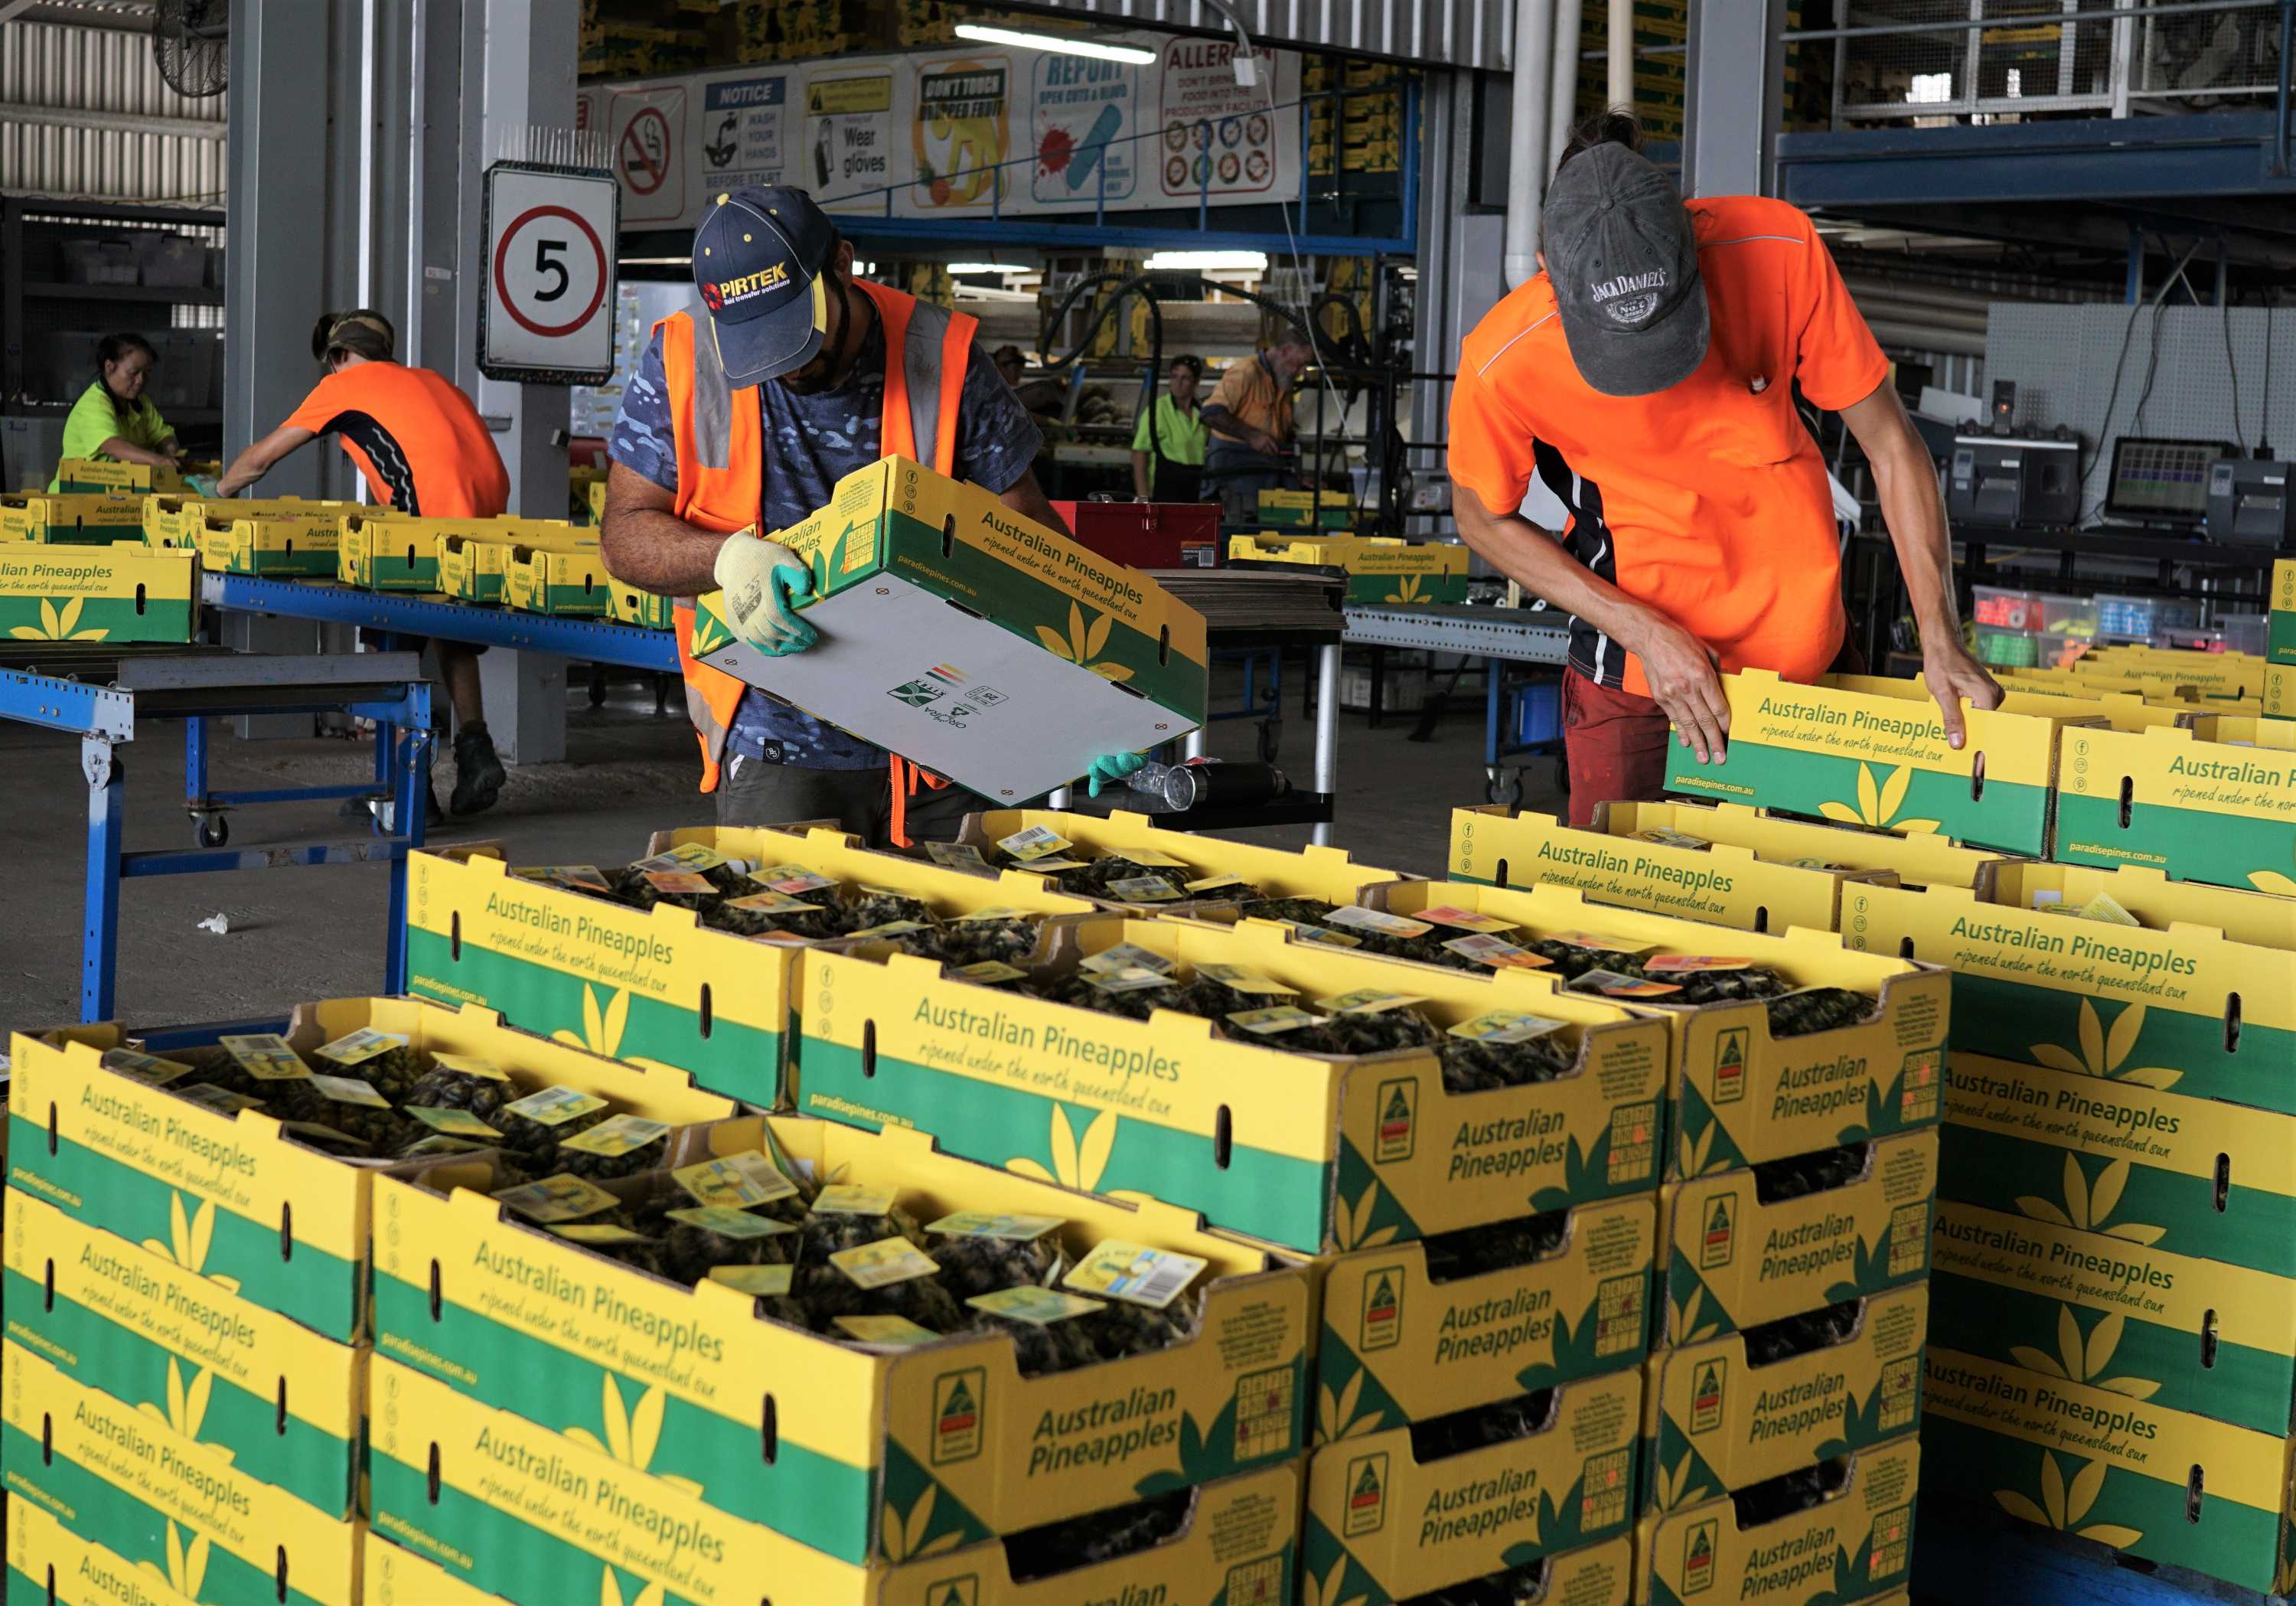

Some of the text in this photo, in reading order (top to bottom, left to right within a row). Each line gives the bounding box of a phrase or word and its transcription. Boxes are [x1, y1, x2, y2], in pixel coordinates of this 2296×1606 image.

[719, 84, 773, 106] NOTICE
[844, 126, 876, 147] Wear
[844, 153, 885, 179] gloves
[534, 239, 569, 302] 5
[719, 260, 789, 299] PIRTEK
[1591, 267, 1666, 302] JACK DANIEL'S
[96, 504, 141, 515] Australian
[33, 564, 113, 580] Pineapples
[897, 554, 977, 597] paradisepines.com.au
[980, 511, 1144, 606] Australian Pineapples
[983, 536, 1140, 622] ripened under the north queensland sun
[1358, 553, 1436, 564] Australian Pineapples
[983, 692, 999, 701] 25
[1759, 697, 1949, 742] Australian Pineapples
[1761, 726, 1943, 762] ripened under the north queensland sun
[1675, 775, 1755, 796] paradisepines.com.au
[2168, 756, 2281, 788] Australian
[2172, 784, 2274, 808] ripened under the
[1538, 841, 1733, 893] Australian Pineapples
[2069, 842, 2167, 864] paradisepines.com.au
[1541, 870, 1726, 915] ripened under the north queensland sun
[486, 892, 673, 965] Australian Pineapples
[1951, 917, 2197, 976] Australian Pineapples
[491, 931, 667, 994] ripened under the north queensland sun
[1955, 948, 2186, 1000] ripened under the north queensland sun
[413, 974, 487, 1006] paradisepines.com.au
[913, 997, 1180, 1082] Australian Pineapples
[918, 1040, 1172, 1118] ripened under the north queensland sun
[1776, 1055, 1867, 1092] Australian
[810, 1092, 914, 1130] paradisepines.com.au
[1772, 1080, 1866, 1119] Pineapples
[1945, 1067, 2180, 1134] Australian Pineapples
[80, 1085, 257, 1177] Australian Pineapples
[1453, 1108, 1564, 1148] Australian
[1945, 1100, 2170, 1158] ripened under the north queensland sun
[1448, 1141, 1564, 1182] Pineapples
[1763, 1213, 1854, 1254] Australian
[1932, 1215, 2174, 1290] Australian Pineapples
[1760, 1238, 1854, 1282] Pineapples
[1935, 1248, 2164, 1313] ripened under the north queensland sun
[80, 1243, 256, 1350] Australian Pineapples
[474, 1241, 726, 1364] Australian Pineapples
[1440, 1288, 1551, 1333] Australian
[1434, 1318, 1551, 1365] Pineapples
[1033, 1386, 1176, 1441] Australian
[1753, 1373, 1844, 1416] Australian
[1923, 1357, 2157, 1439] Australian Pineapples
[1749, 1399, 1844, 1444] Pineapples
[1964, 1399, 1998, 1418] under
[2000, 1405, 2020, 1426] the
[2023, 1417, 2057, 1436] north
[2059, 1424, 2125, 1457] queensland
[2126, 1447, 2148, 1464] sun
[76, 1401, 250, 1517] Australian Pineapples
[1028, 1419, 1178, 1477] Pineapples
[475, 1426, 726, 1562] Australian Pineapples
[1424, 1468, 1536, 1517] Australian
[1420, 1498, 1537, 1548] Pineapples
[1744, 1526, 1835, 1574] Australian
[1740, 1550, 1835, 1601] Pineapples
